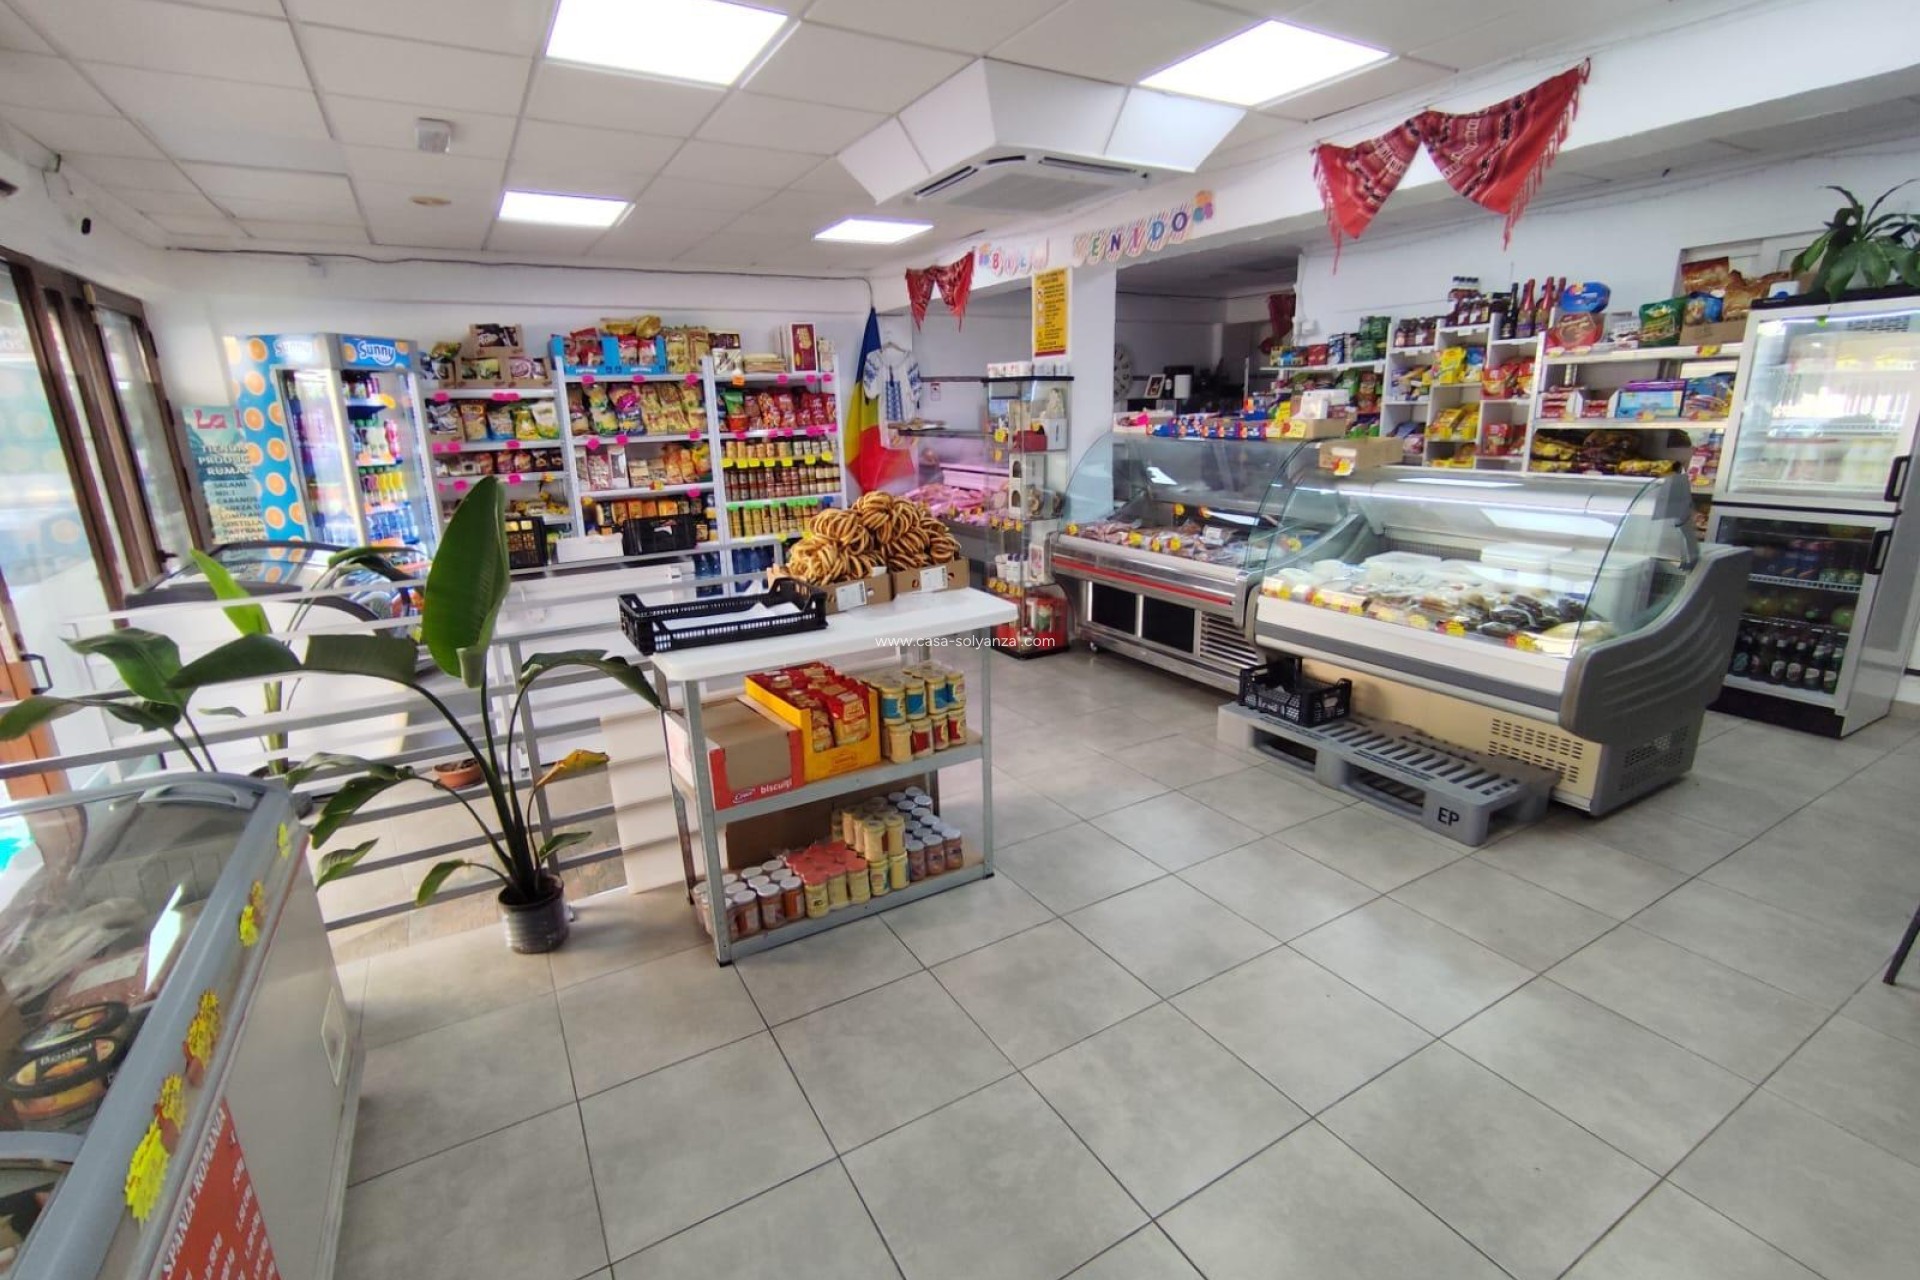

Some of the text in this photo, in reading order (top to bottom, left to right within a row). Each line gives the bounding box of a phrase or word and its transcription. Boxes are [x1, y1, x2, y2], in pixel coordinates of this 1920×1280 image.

[1077, 211, 1189, 262] ENIDO
[360, 343, 393, 362] Sunny
[1438, 807, 1459, 826] EP
